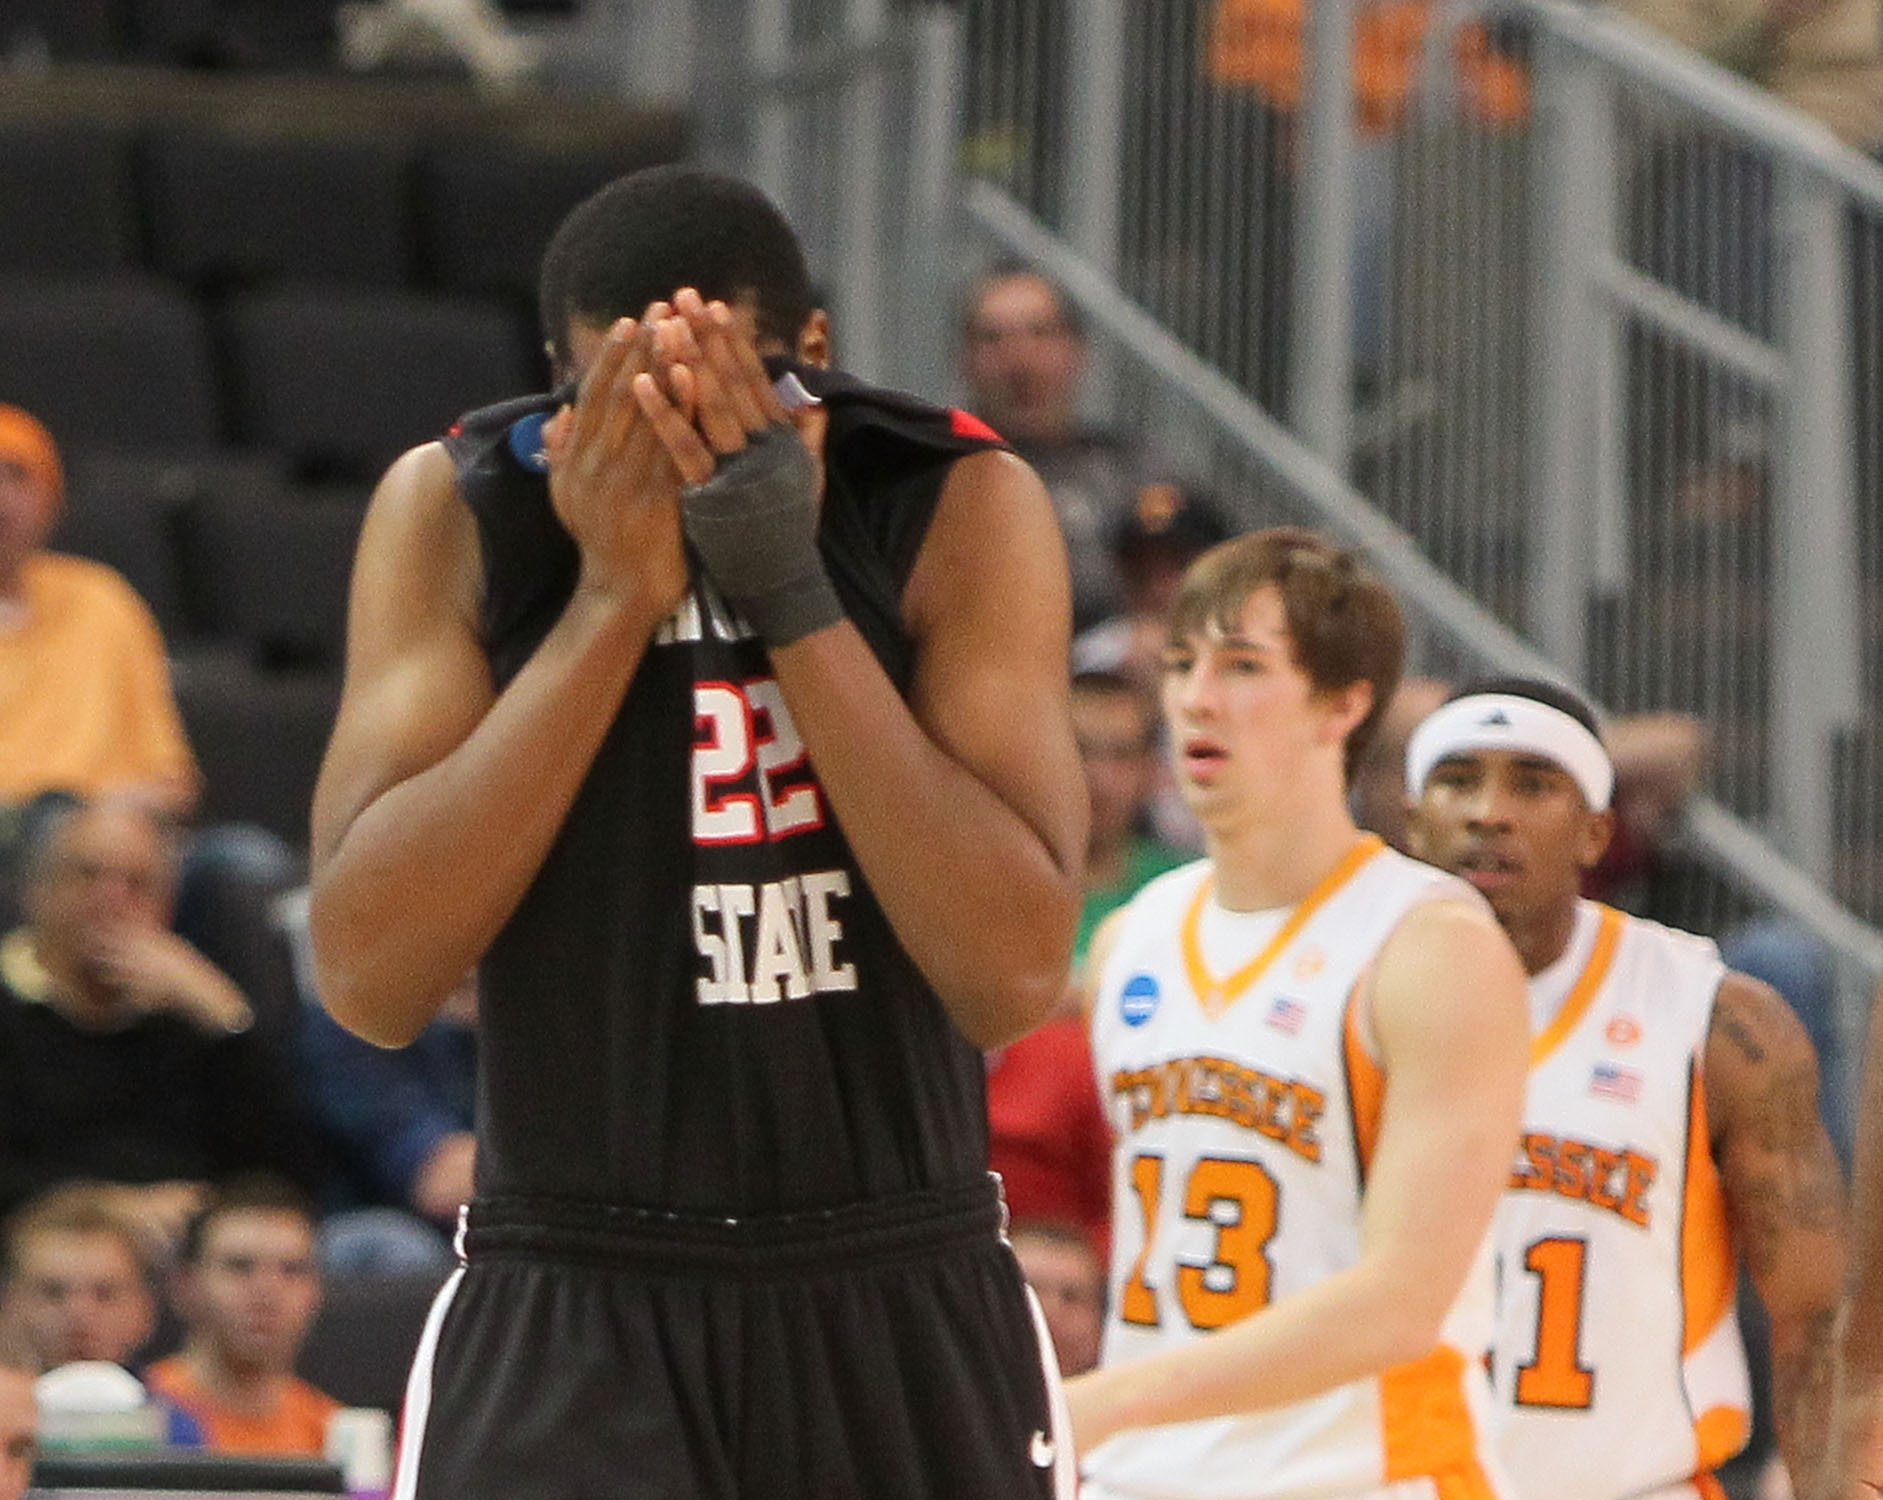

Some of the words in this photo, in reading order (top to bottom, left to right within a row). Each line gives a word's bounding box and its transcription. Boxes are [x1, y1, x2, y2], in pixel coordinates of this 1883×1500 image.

[690, 680, 824, 846] 22
[1121, 1153, 1280, 1331] 13
[1482, 1233, 1594, 1409] 1
